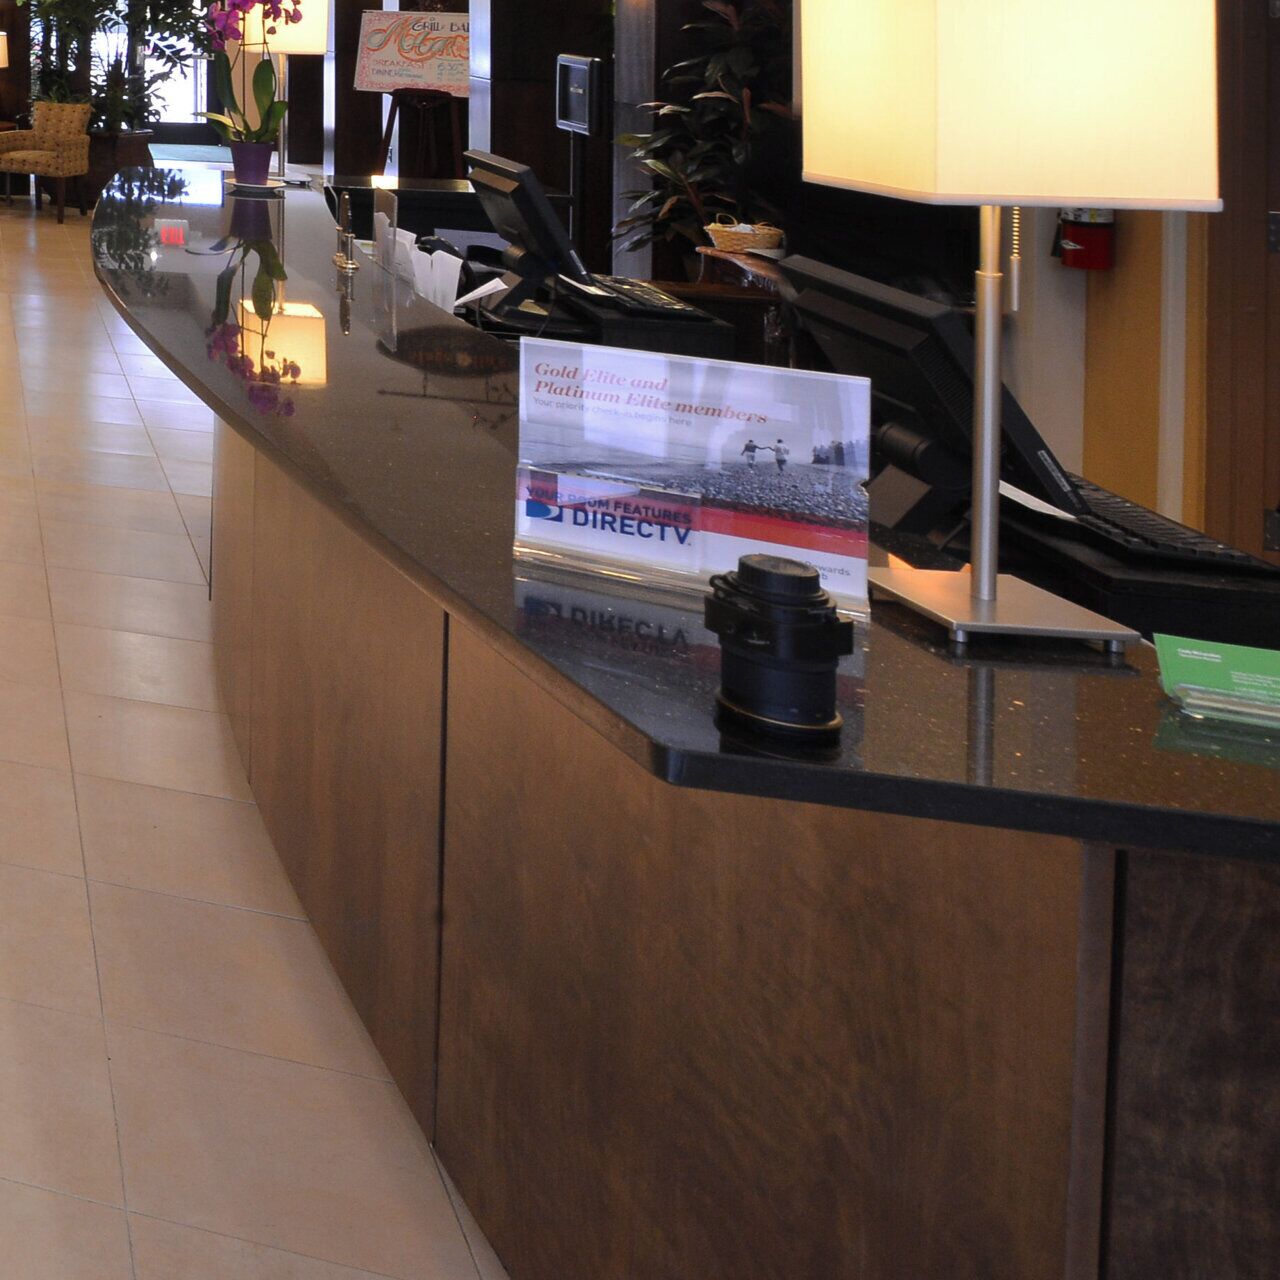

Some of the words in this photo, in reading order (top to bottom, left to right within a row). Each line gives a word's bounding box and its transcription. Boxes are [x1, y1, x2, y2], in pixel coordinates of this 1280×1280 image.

[535, 362, 578, 380] Gold
[583, 369, 627, 386] Elite
[630, 378, 668, 391] and
[534, 380, 620, 404] Platinum
[626, 393, 672, 412] Elite
[674, 402, 768, 424] members
[572, 509, 692, 546] DIRECTV
[614, 501, 692, 525] FEATURES
